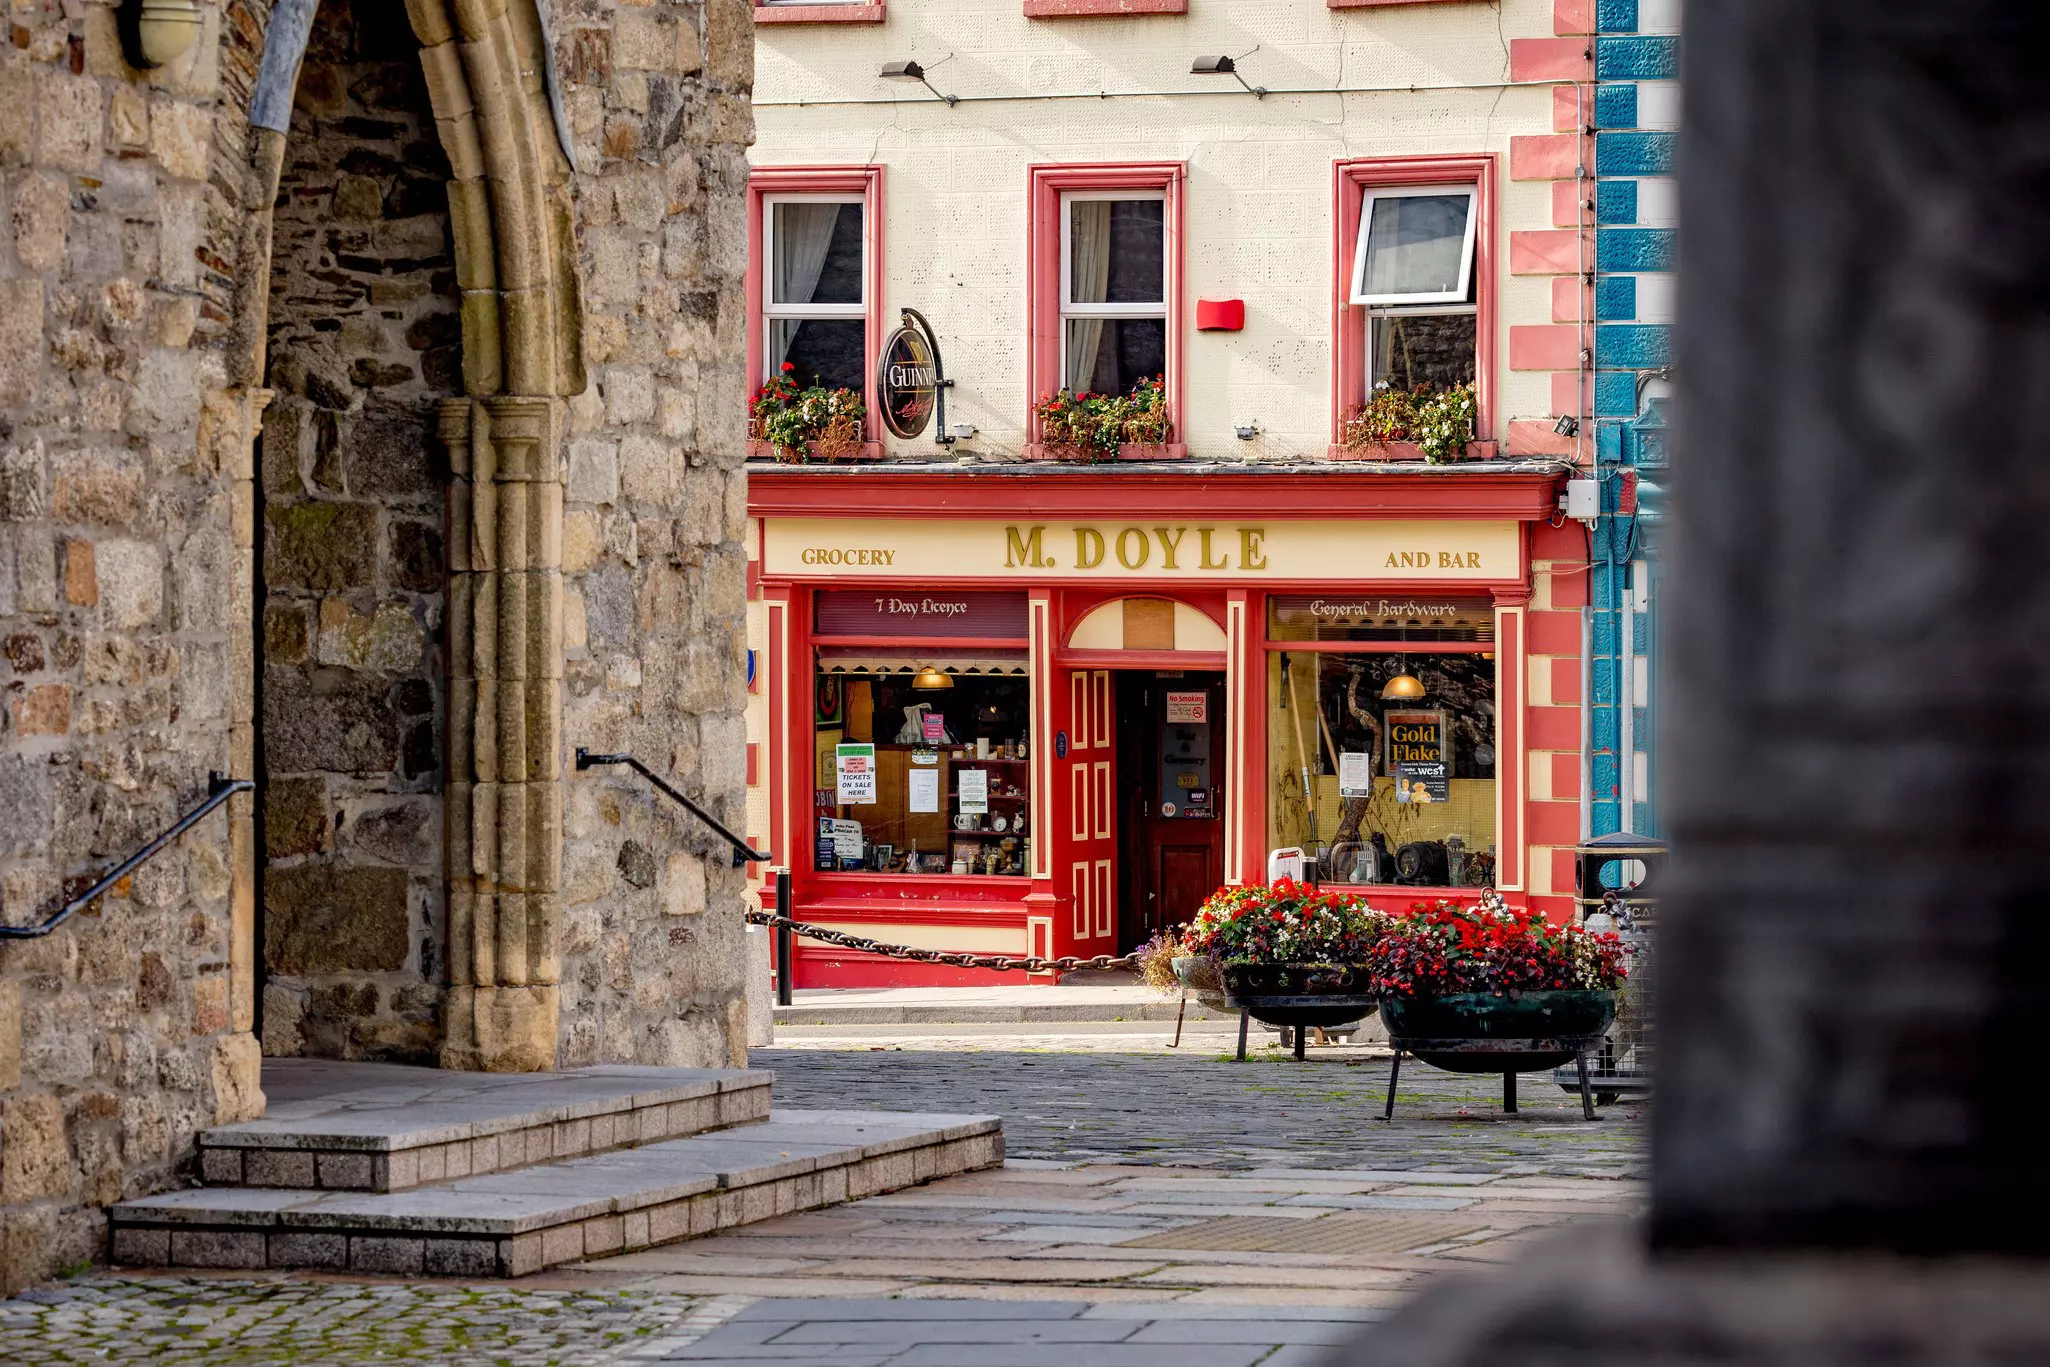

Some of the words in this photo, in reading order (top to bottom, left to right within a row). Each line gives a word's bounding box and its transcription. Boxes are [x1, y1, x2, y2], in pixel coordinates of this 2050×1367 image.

[801, 548, 896, 566] GROCERY
[1003, 526, 1056, 568] M.
[1072, 527, 1269, 570] DOYLE
[1384, 551, 1430, 568] AND
[1438, 551, 1481, 568] BAR
[873, 599, 883, 613] 7
[888, 599, 919, 619] Day
[921, 598, 968, 618] Licence
[1310, 600, 1370, 620] General
[1179, 694, 1204, 704] Smoking
[1392, 725, 1436, 743] Gold
[1392, 744, 1440, 761] Flake
